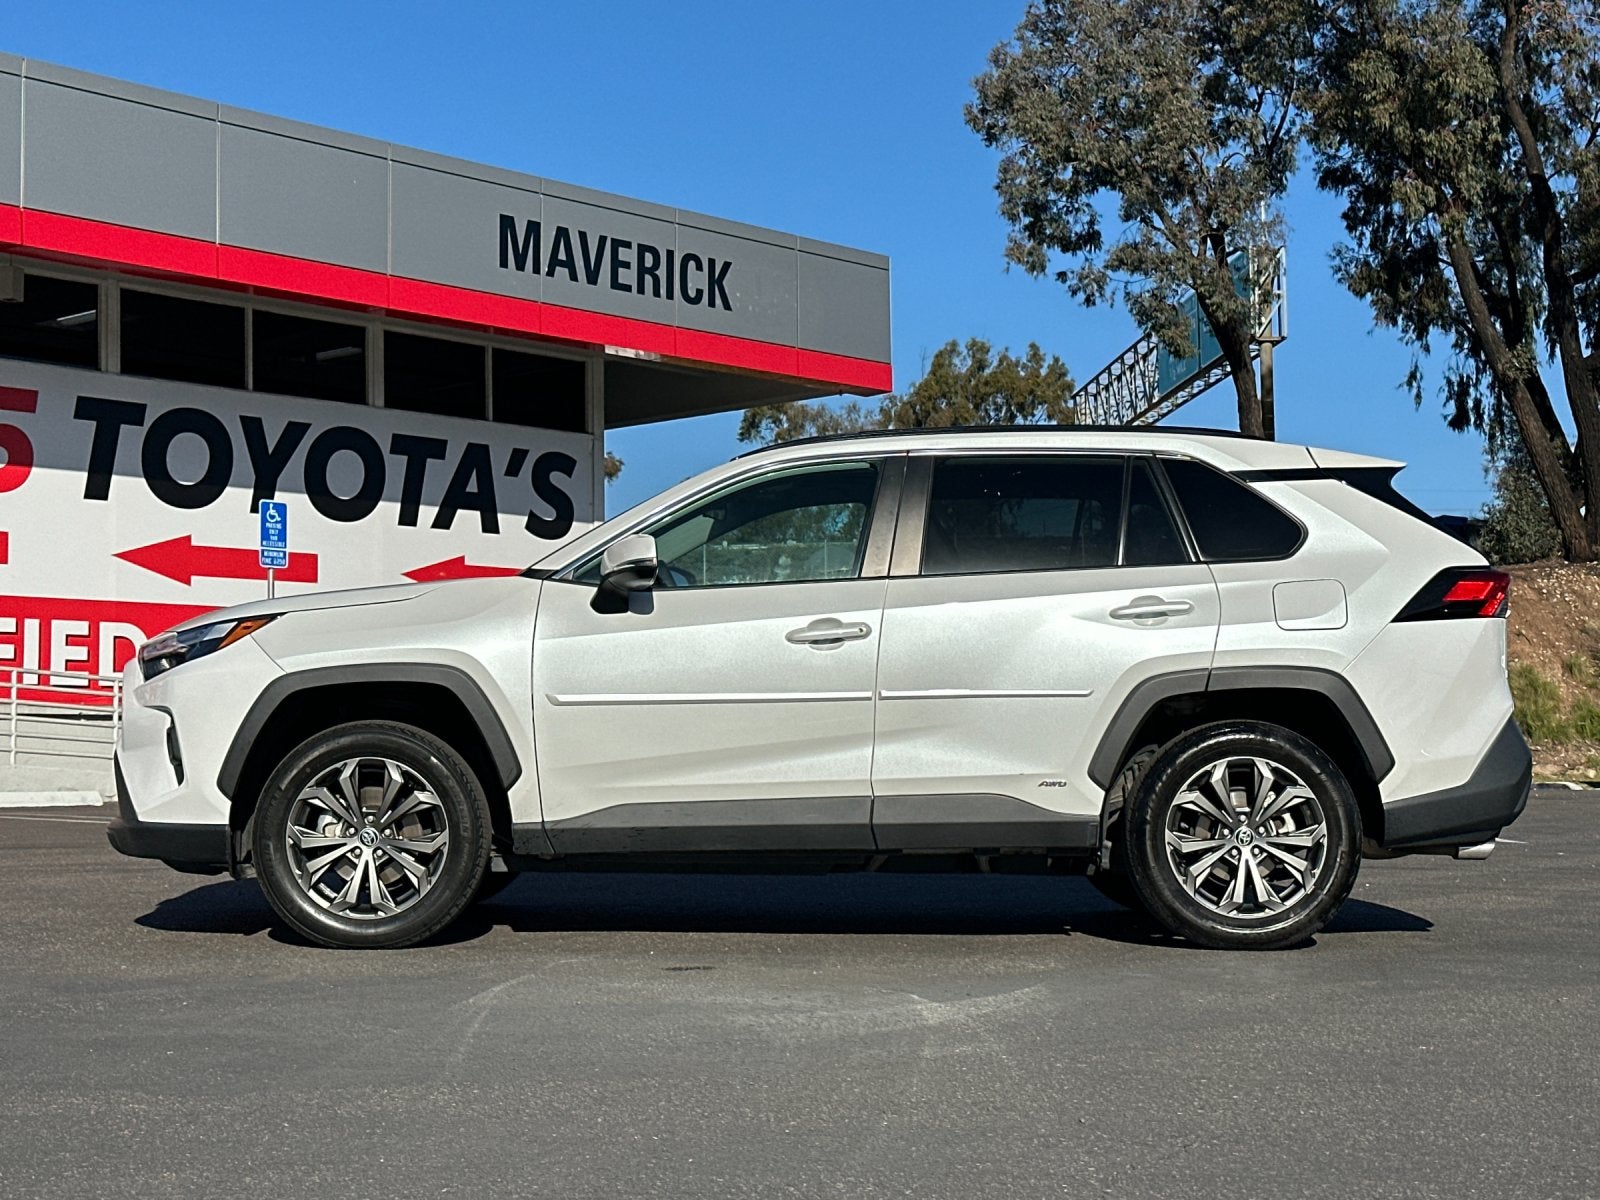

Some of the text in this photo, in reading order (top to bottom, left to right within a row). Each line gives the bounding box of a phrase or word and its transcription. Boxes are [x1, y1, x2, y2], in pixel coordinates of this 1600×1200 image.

[499, 213, 733, 312] MAVERICK
[73, 395, 577, 540] TOYOTA'S
[1037, 780, 1067, 788] AWD
